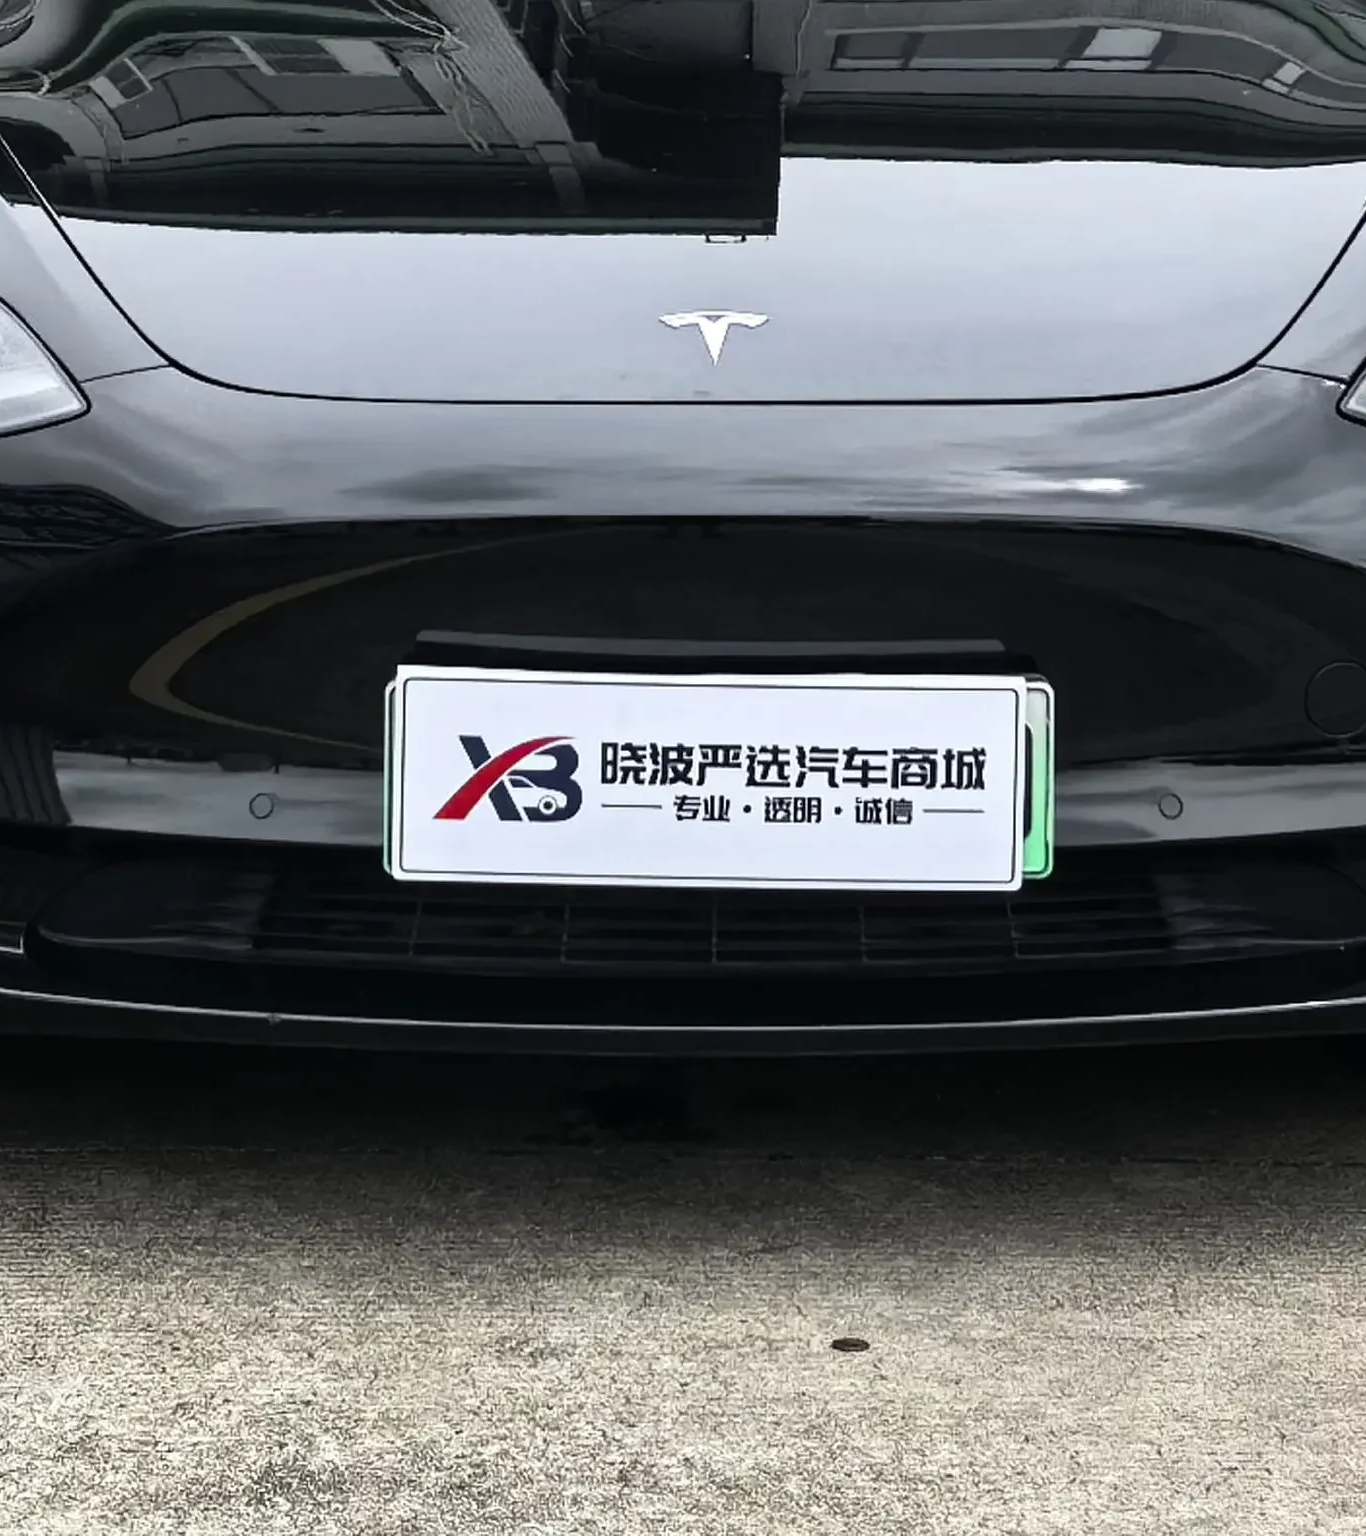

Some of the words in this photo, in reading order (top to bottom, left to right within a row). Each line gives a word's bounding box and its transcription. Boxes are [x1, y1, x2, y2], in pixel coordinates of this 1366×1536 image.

[432, 735, 583, 822] XB
[601, 742, 987, 790] 晓波严选汽车商城
